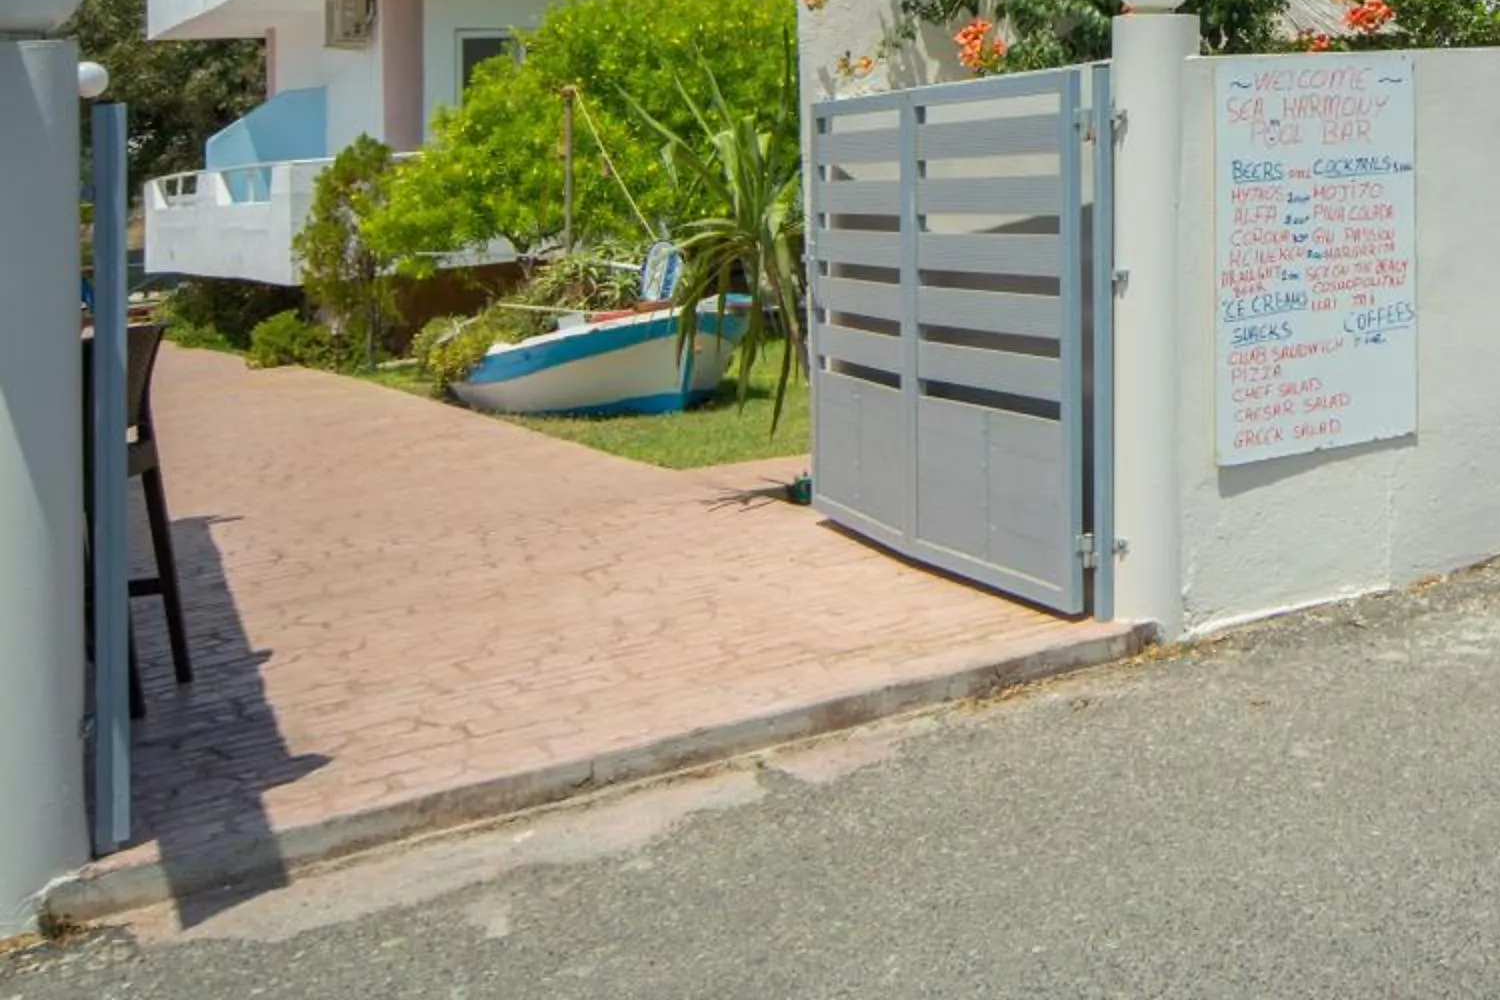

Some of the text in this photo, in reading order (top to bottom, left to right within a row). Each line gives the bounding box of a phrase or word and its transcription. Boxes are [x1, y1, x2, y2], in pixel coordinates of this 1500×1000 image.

[1254, 67, 1372, 92] WELCOME
[1226, 95, 1390, 123] SEA HARMONY
[1322, 120, 1372, 145] BAR
[1231, 159, 1284, 183] BEERS
[1312, 156, 1392, 178] COCKTAILS
[1343, 301, 1416, 334] COFFEES
[1232, 320, 1294, 346] SNACKS
[1231, 364, 1282, 384] PIZZA
[1232, 377, 1323, 403] CHEF SALAD
[1304, 392, 1352, 414] SALAD
[1233, 418, 1342, 449] GREEK SALAD
